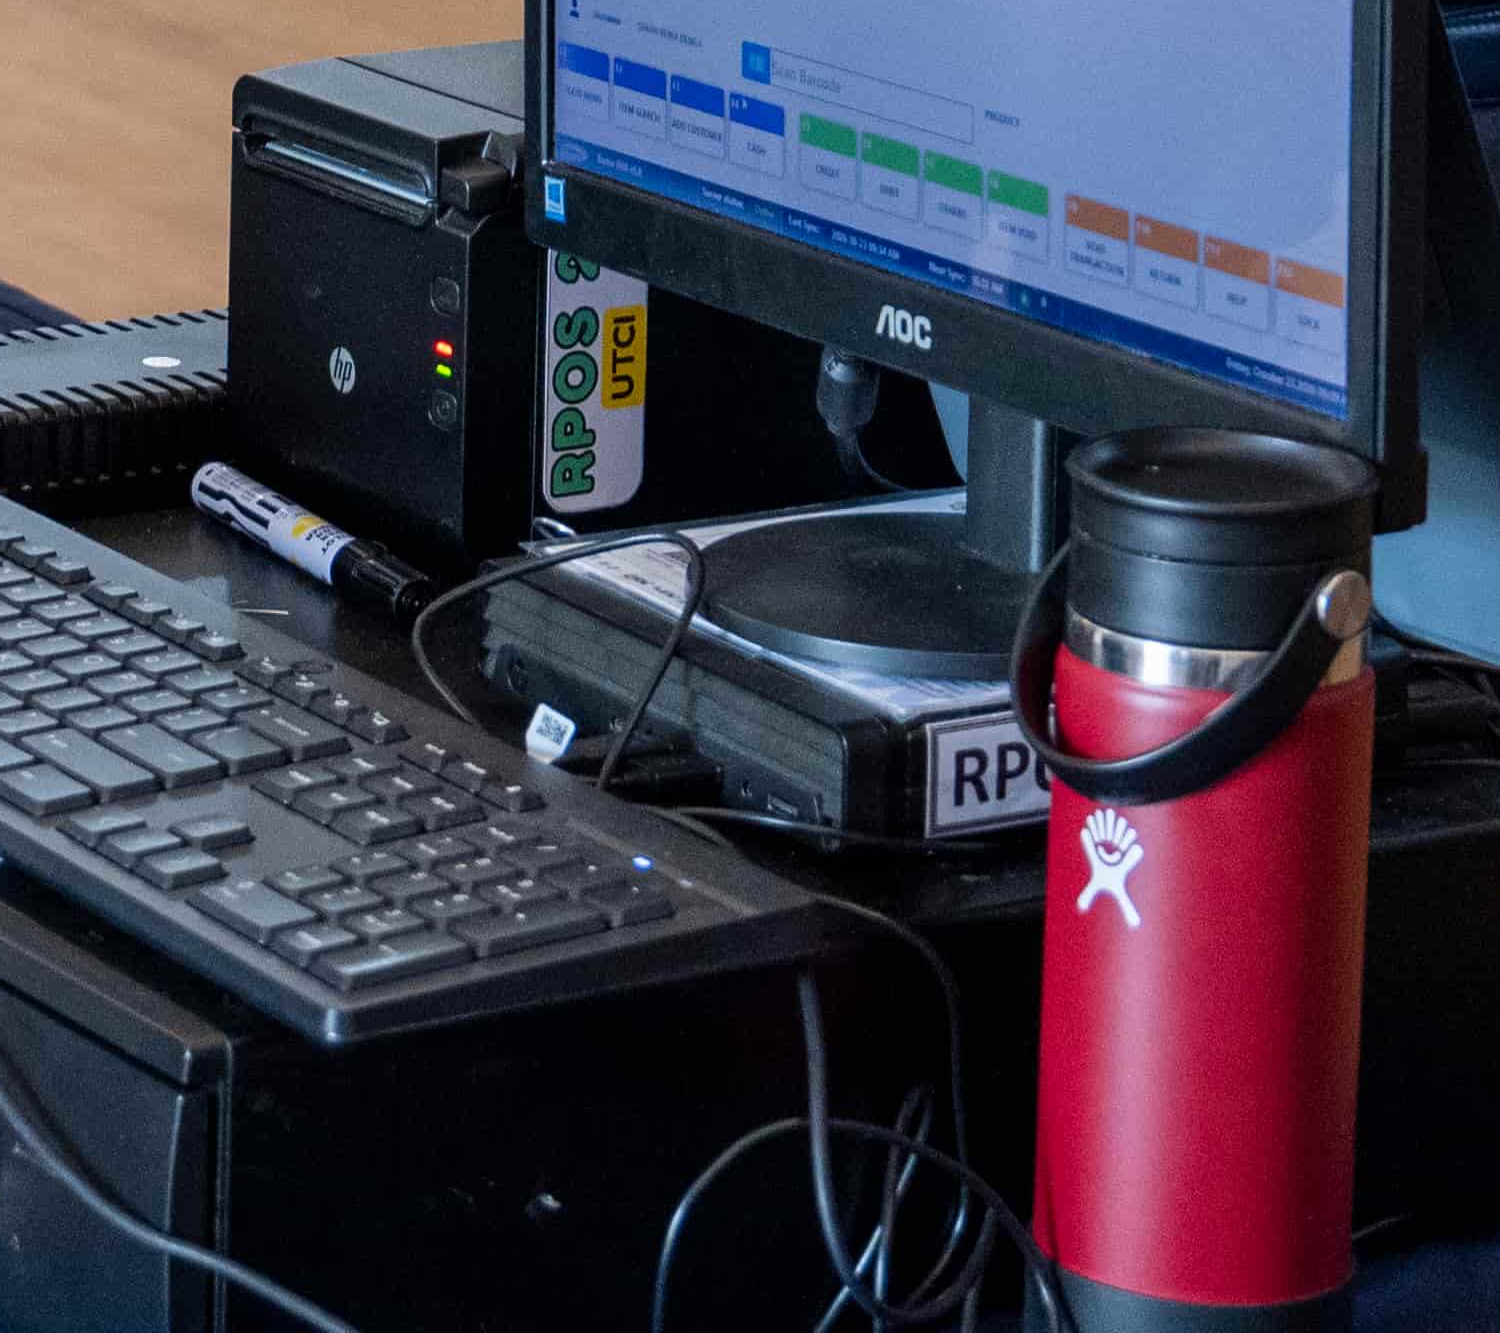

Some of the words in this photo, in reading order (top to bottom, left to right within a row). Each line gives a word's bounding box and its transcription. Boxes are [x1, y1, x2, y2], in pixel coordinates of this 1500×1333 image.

[771, 60, 797, 79] Scan
[799, 67, 841, 94] Barcode
[876, 305, 932, 350] AOC
[333, 348, 353, 392] hp
[612, 314, 636, 400] UTCI
[551, 306, 600, 498] RPOS
